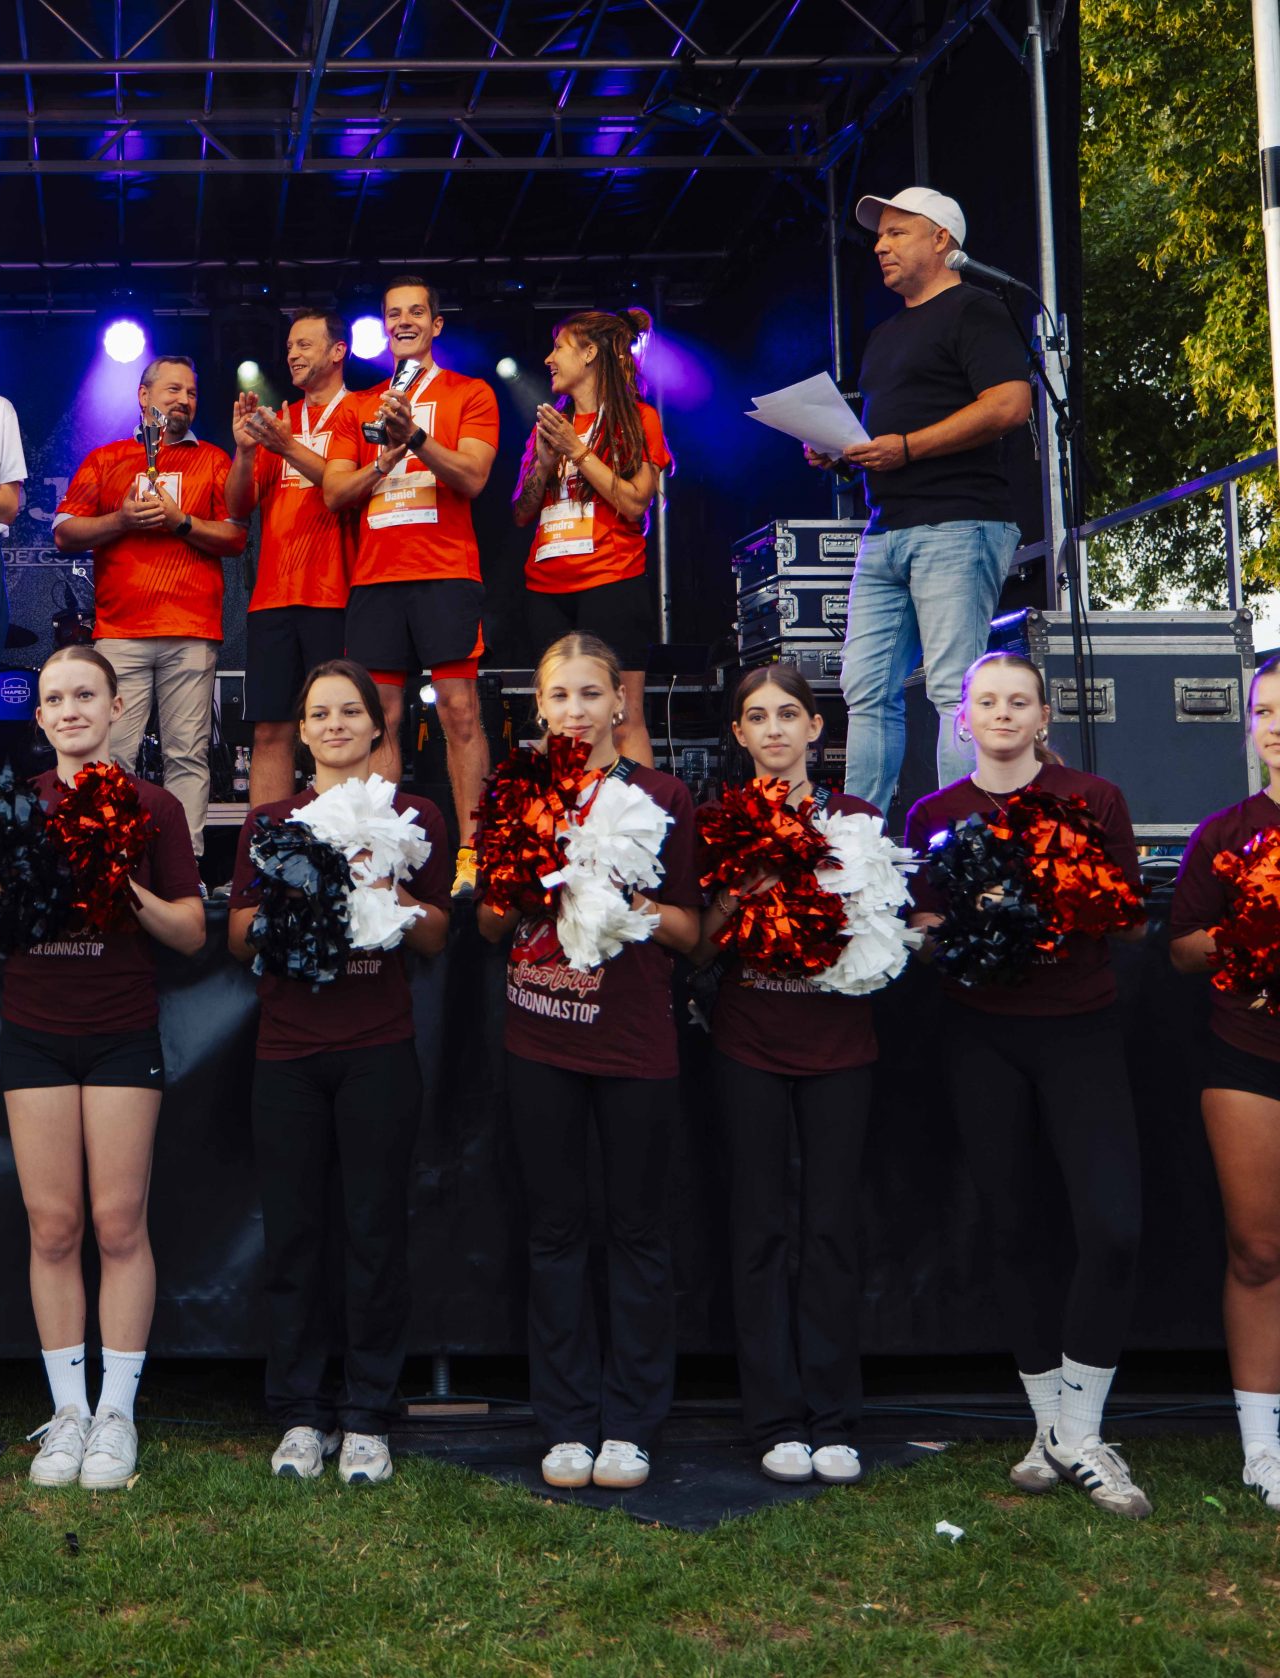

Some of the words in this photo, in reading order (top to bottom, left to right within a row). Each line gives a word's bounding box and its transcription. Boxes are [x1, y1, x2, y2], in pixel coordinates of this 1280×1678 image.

[842, 391, 863, 399] SHU
[384, 488, 416, 502] Daniel
[543, 519, 574, 533] Sandra
[513, 959, 551, 988] Spice
